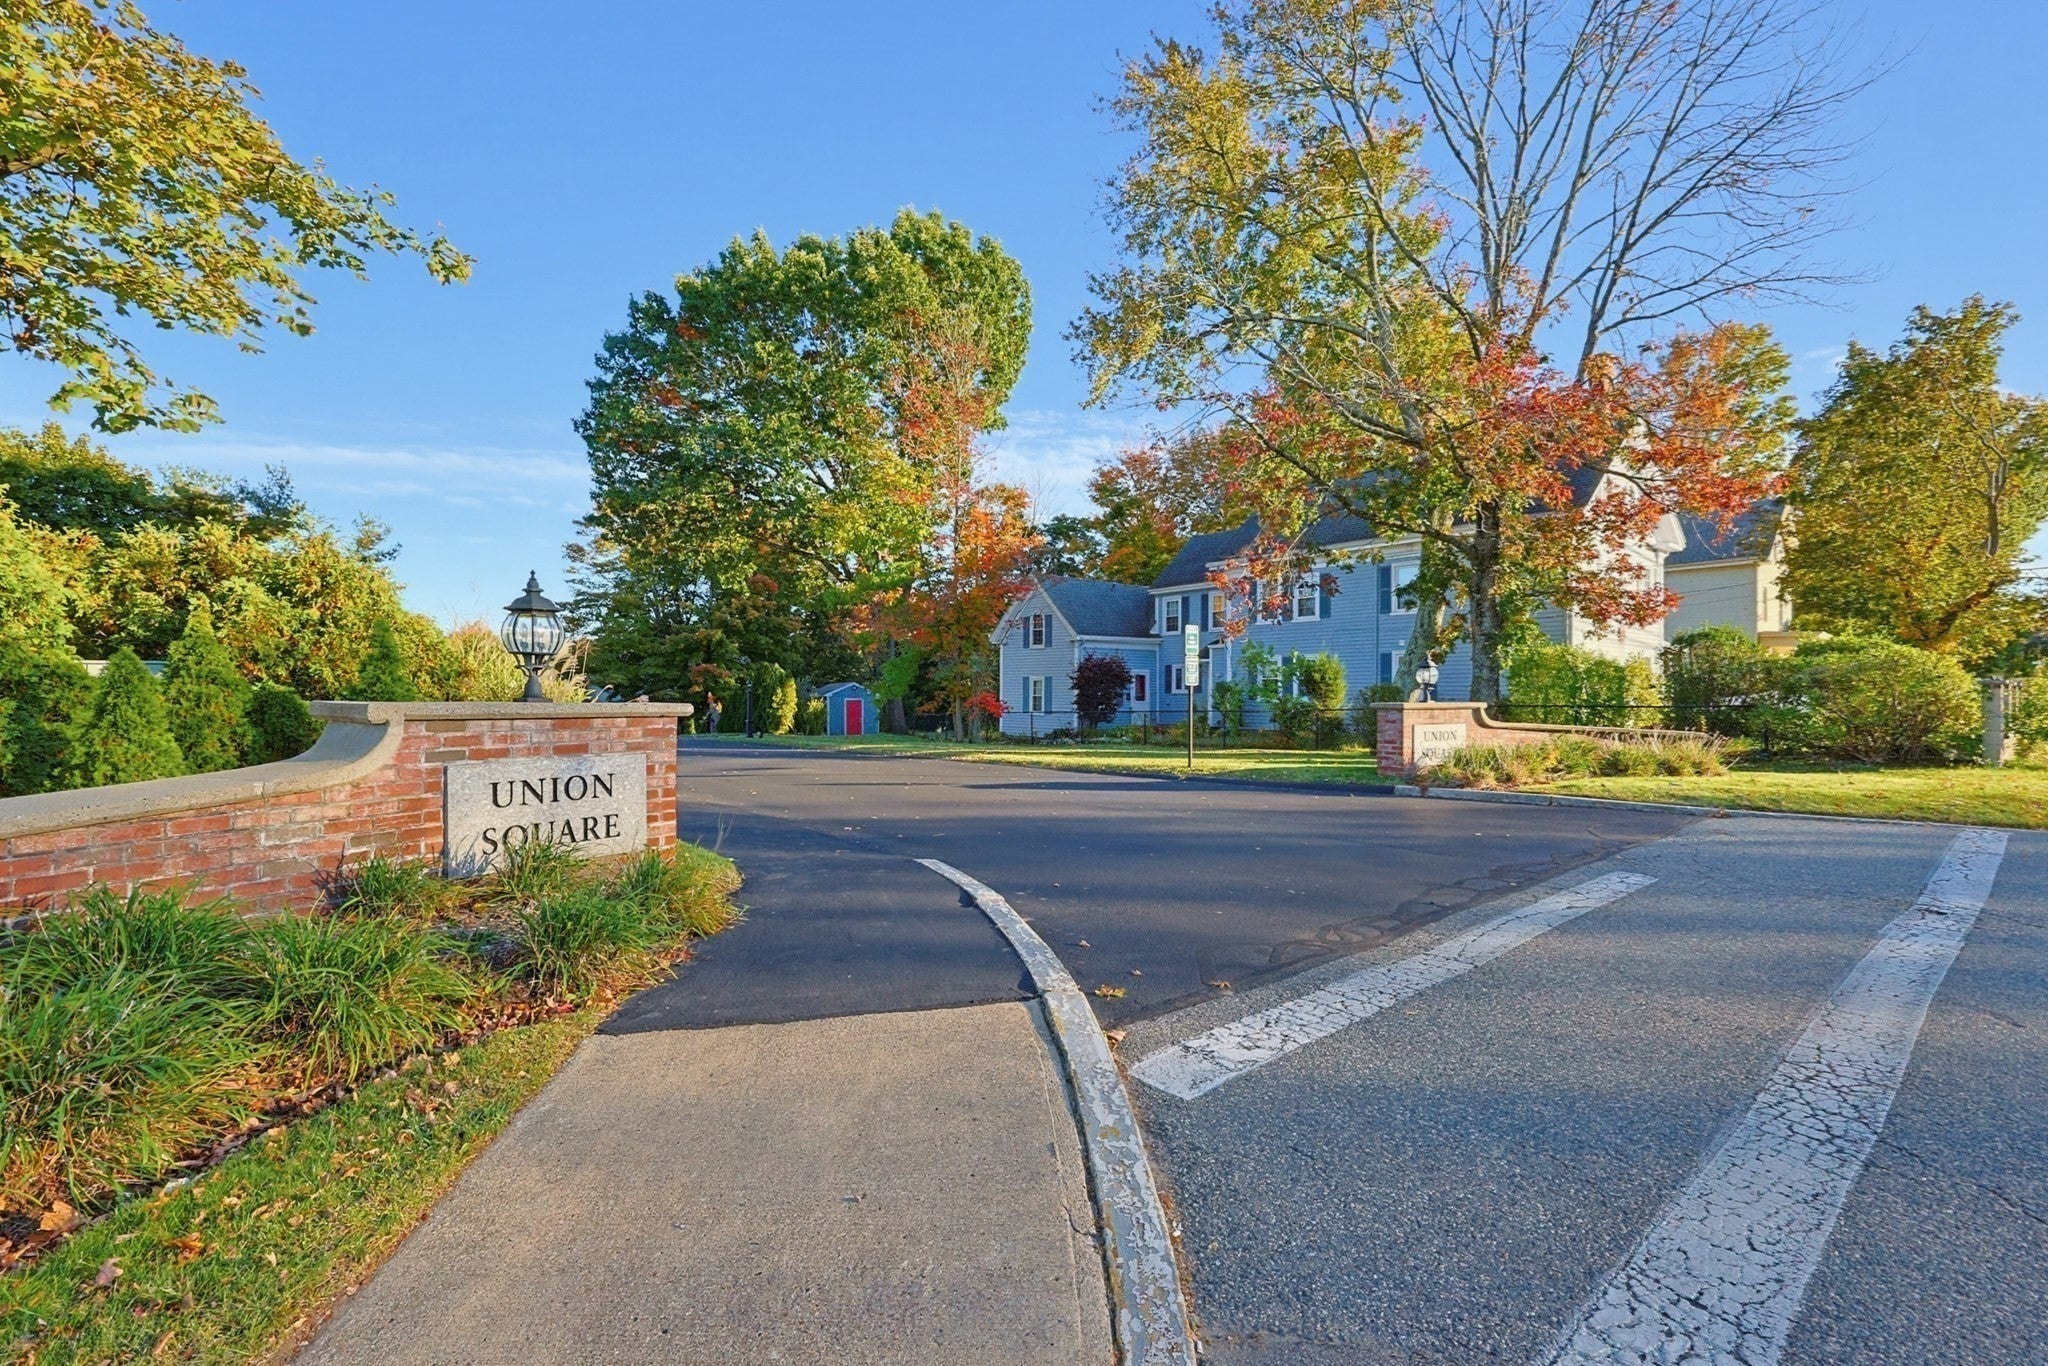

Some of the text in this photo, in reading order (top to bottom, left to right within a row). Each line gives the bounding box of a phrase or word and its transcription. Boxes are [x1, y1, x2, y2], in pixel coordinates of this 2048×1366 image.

[1424, 730, 1457, 742] UNION
[489, 773, 615, 808] UNION
[482, 814, 621, 855] SQUARE
